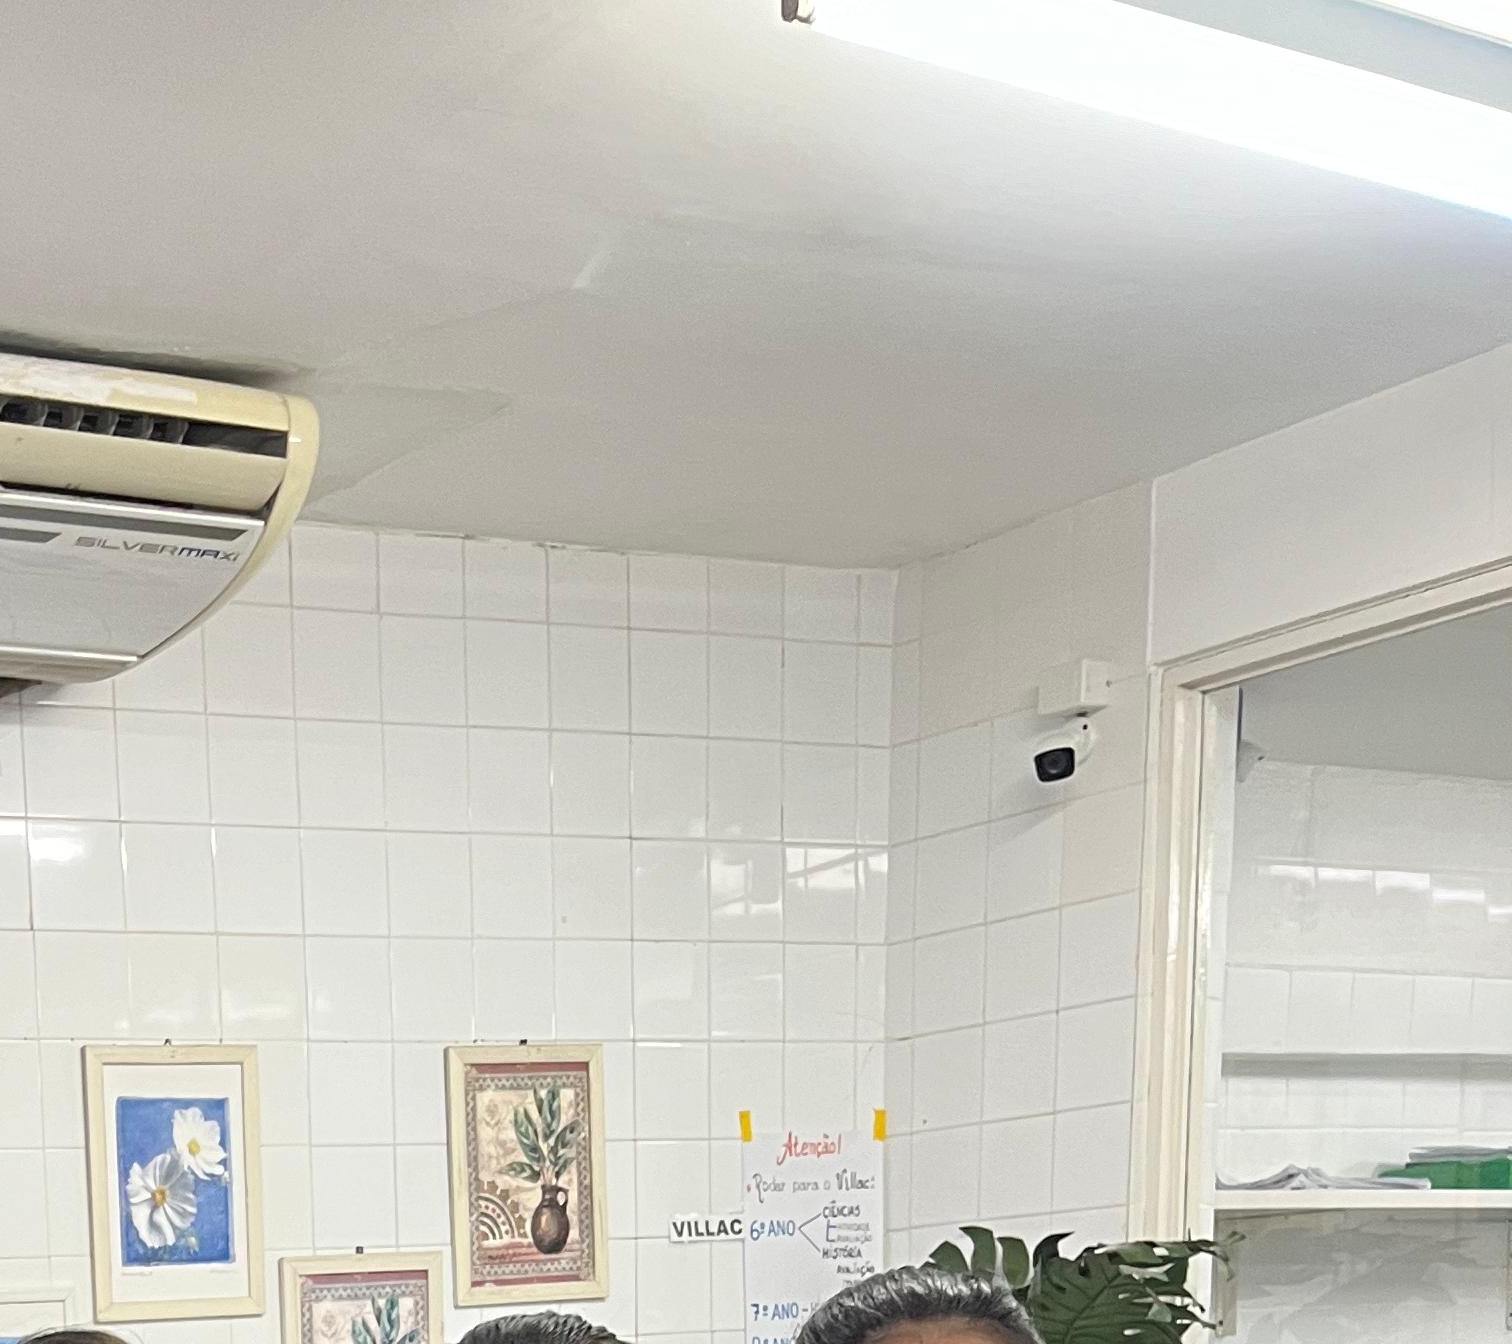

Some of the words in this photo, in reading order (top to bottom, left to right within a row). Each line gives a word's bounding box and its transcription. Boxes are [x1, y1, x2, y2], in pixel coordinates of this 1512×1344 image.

[672, 1218, 744, 1239] VILLAC
[767, 1219, 796, 1237] ANO
[771, 1302, 799, 1320] ANO
